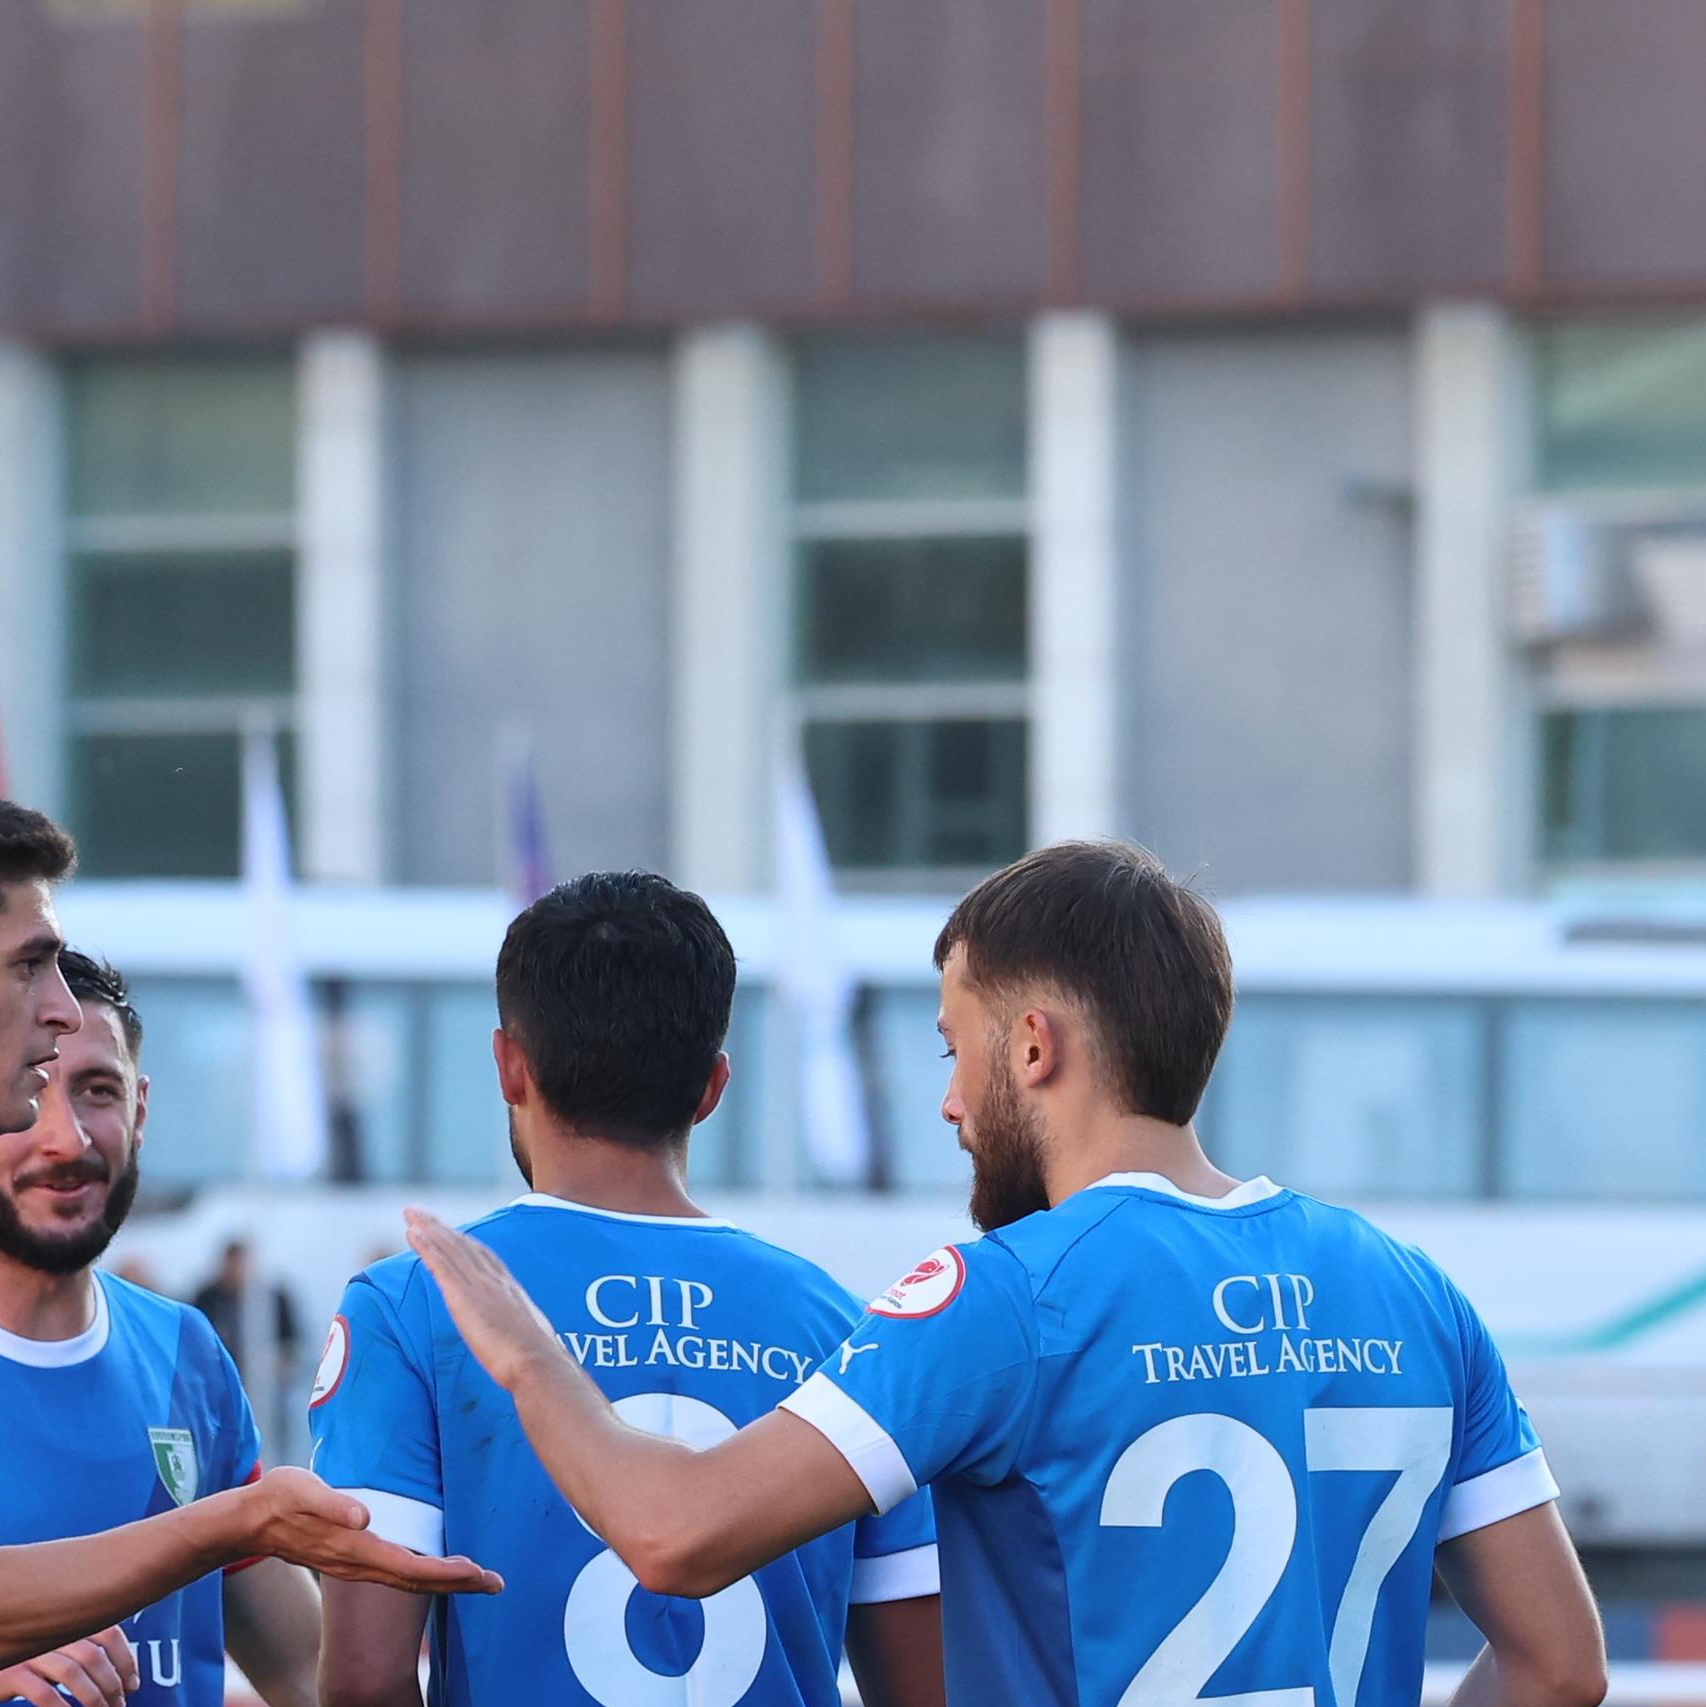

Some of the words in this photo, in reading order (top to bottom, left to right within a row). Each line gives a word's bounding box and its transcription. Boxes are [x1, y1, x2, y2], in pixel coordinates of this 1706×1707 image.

[585, 1274, 714, 1330] CIP
[1212, 1273, 1315, 1335] CIP
[557, 1332, 638, 1367] VEL
[644, 1328, 813, 1384] AGENCY
[1132, 1341, 1269, 1384] TRAVEL
[1275, 1333, 1403, 1374] AGENCY
